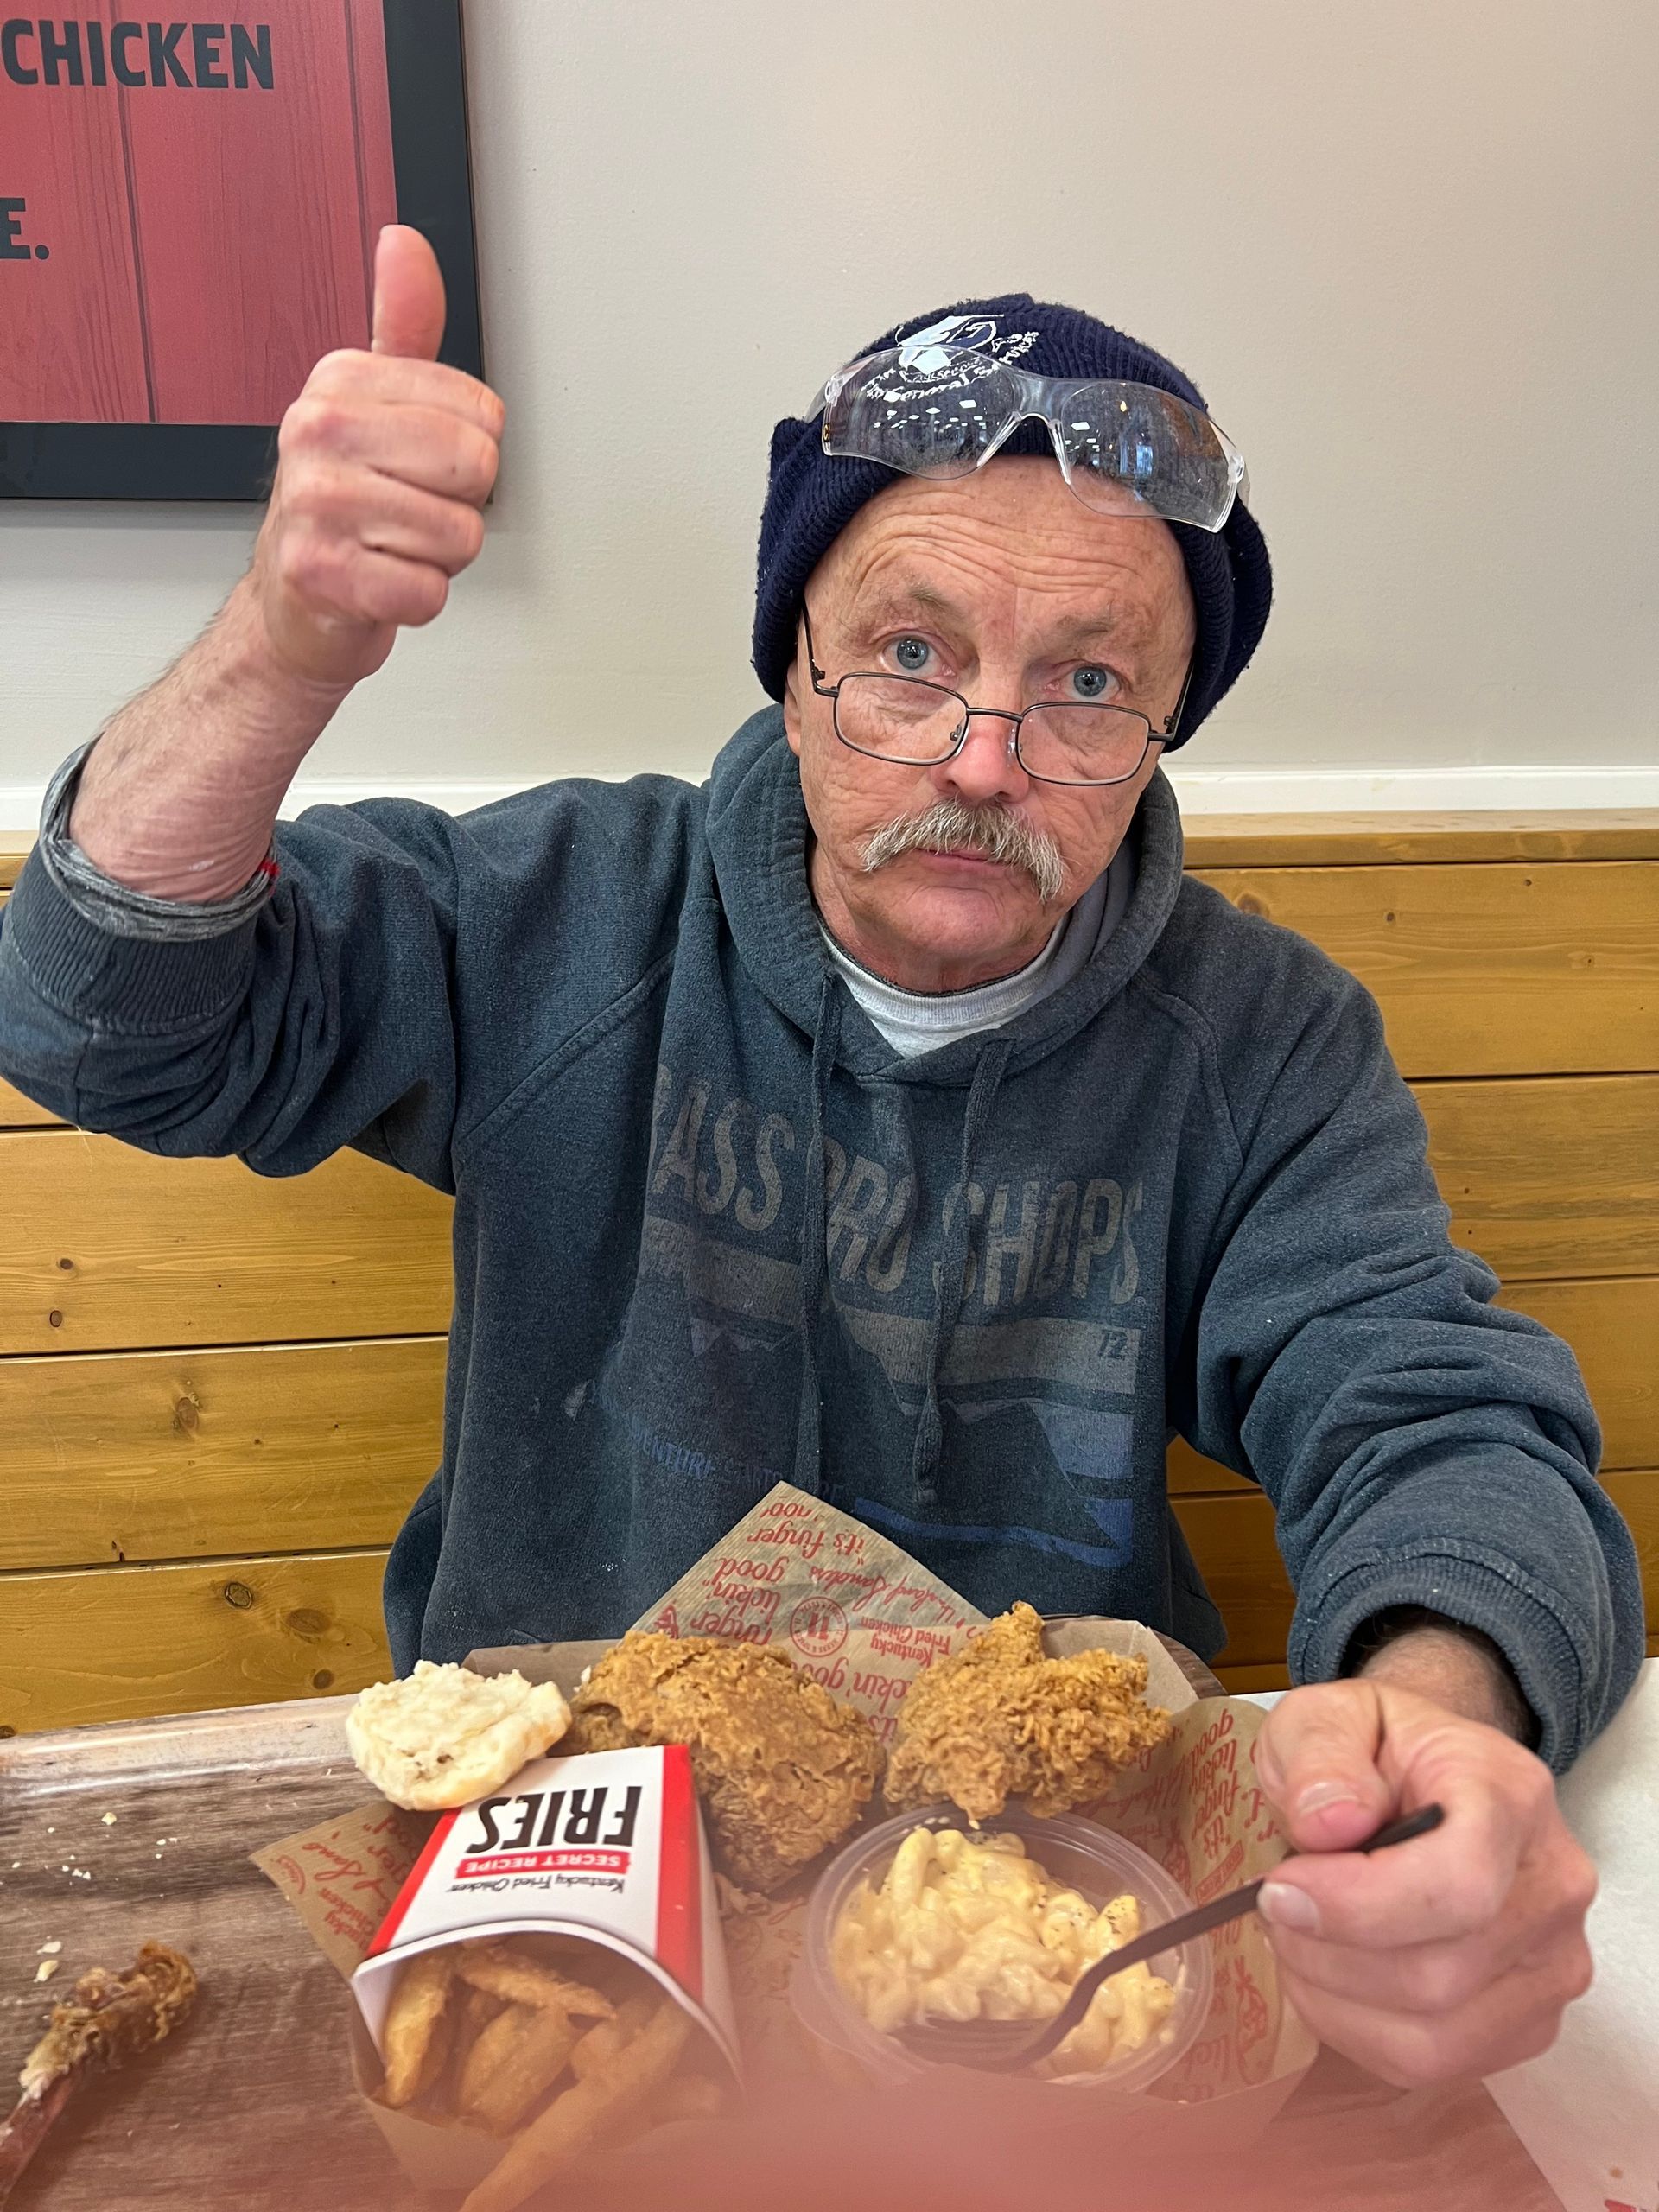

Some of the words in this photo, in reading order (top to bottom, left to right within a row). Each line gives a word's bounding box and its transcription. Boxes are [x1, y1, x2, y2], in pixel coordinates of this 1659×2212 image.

[1, 19, 275, 90] CHICKEN
[746, 1520, 825, 1559] finger
[857, 1615, 913, 1643] Chicken
[869, 1635, 933, 1669] Kentucky
[916, 1630, 951, 1656] Fried
[464, 1785, 643, 1854] FRIES
[464, 1855, 538, 1873] RECIPE
[541, 1853, 621, 1867] SECRET
[512, 1873, 552, 1890] Fried
[555, 1873, 625, 1894] Kentucky
